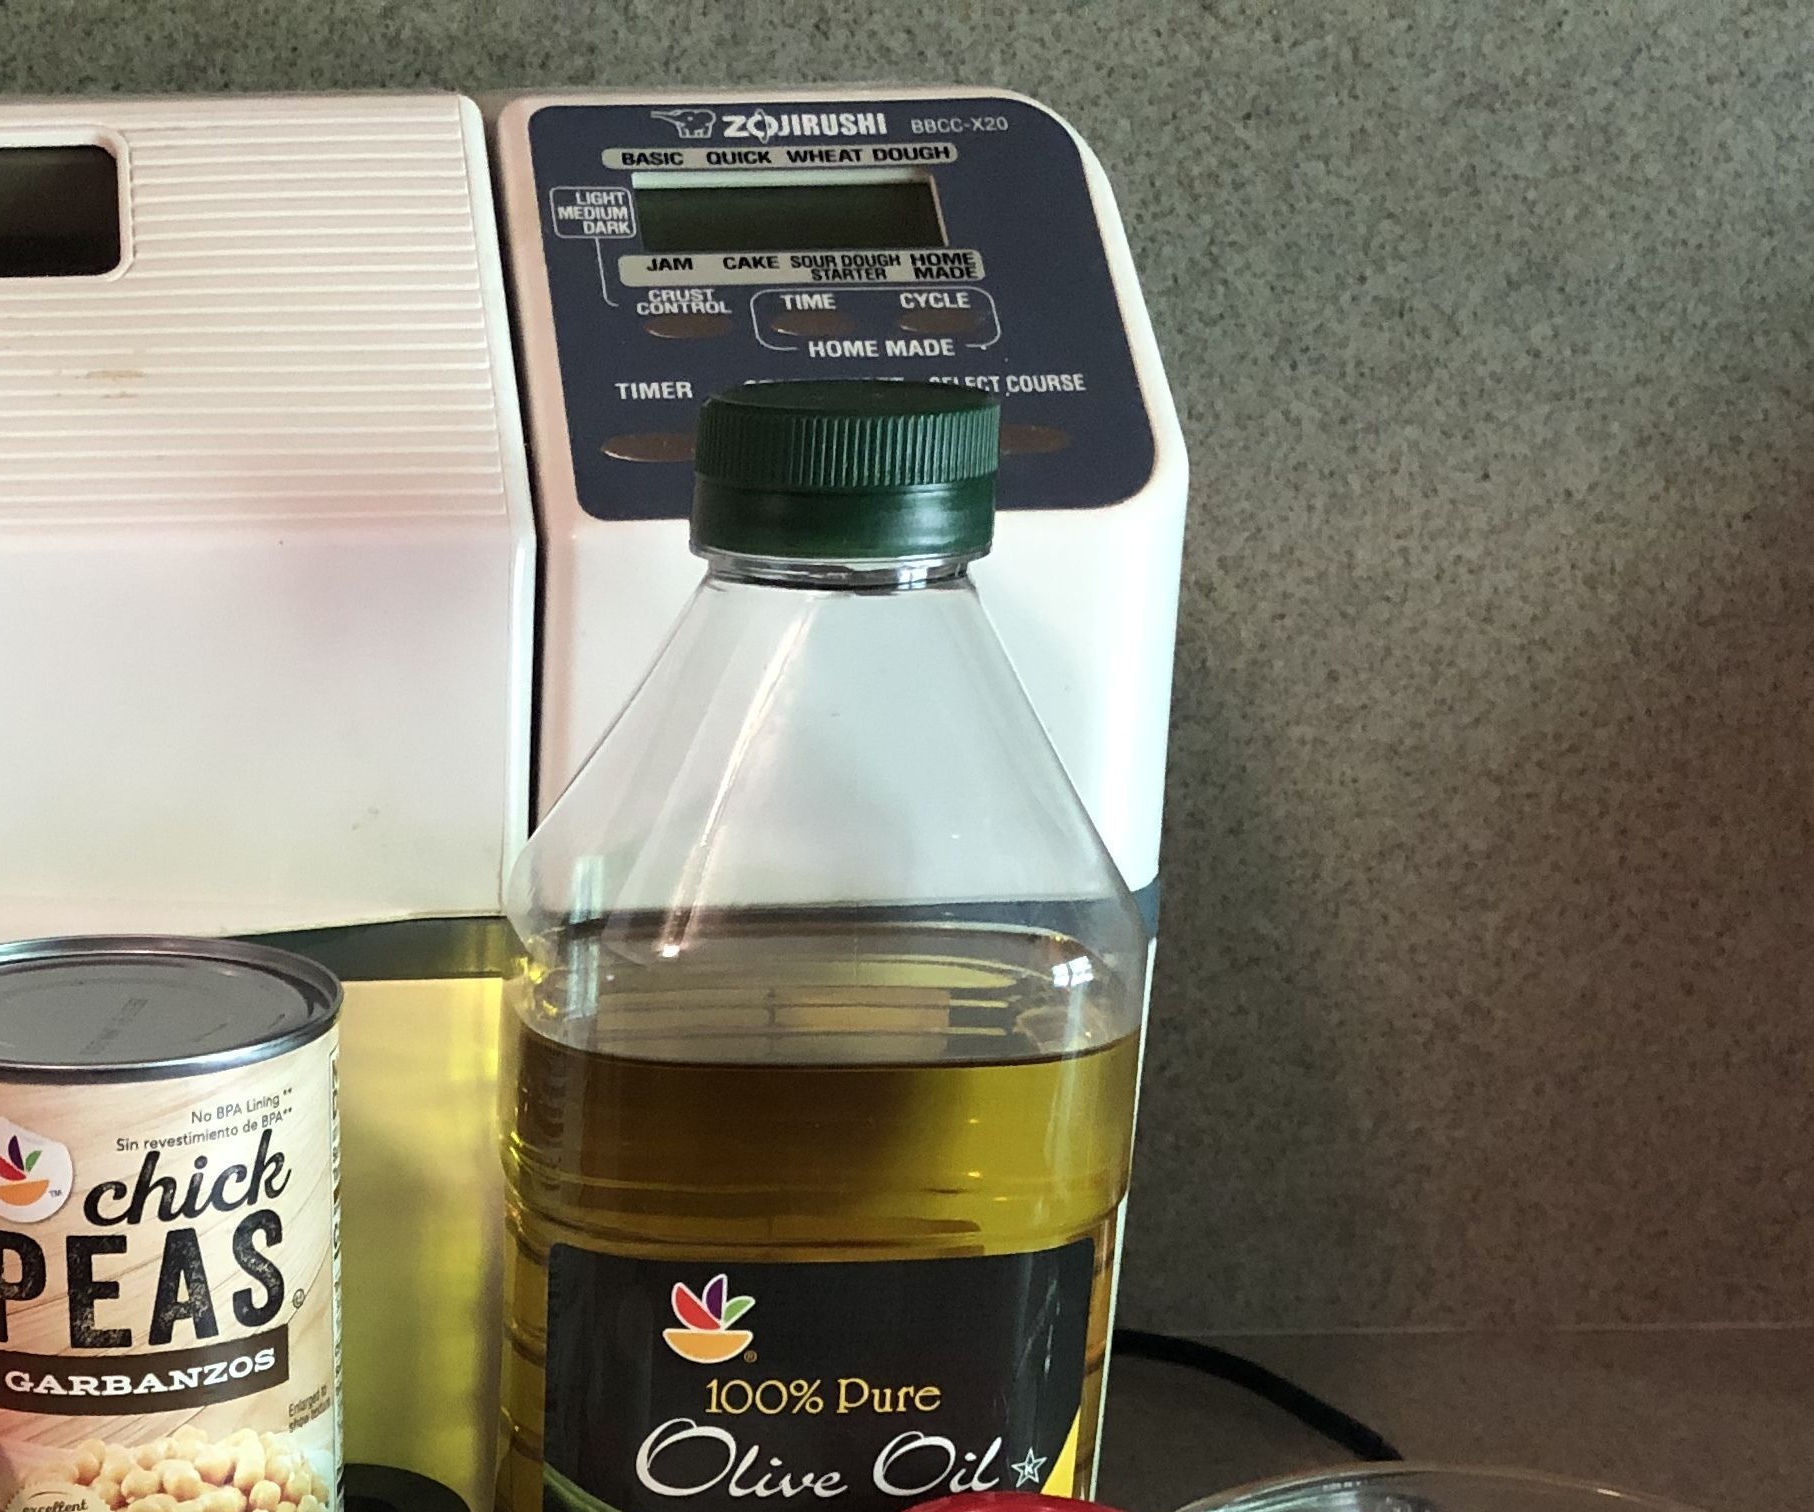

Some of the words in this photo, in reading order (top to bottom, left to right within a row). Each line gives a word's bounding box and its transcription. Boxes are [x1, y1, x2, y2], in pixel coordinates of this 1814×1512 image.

[723, 112, 886, 141] ZOJIRUSHI
[911, 116, 1008, 133] BBCC-X20
[621, 152, 684, 166] BASIC
[706, 149, 772, 165] QUICK
[787, 147, 862, 164] WHEAT
[872, 146, 950, 162] DOUGH
[575, 191, 624, 206] LIGHT
[558, 206, 628, 221] MEDIUM
[584, 220, 631, 235] DARK
[647, 257, 693, 272] JAM
[723, 255, 779, 271] CAKE
[791, 254, 837, 269] SOUR
[841, 253, 900, 268] DOUGH
[911, 252, 974, 267] HOME
[811, 268, 886, 282] STARTER
[915, 265, 977, 280] MADE
[648, 289, 714, 304] CRUST
[784, 294, 835, 310] TIME
[900, 293, 970, 309] CYCLE
[637, 300, 731, 316] CONTROL
[809, 340, 878, 357] HOME
[886, 340, 954, 357] MADE
[616, 382, 692, 400] TIMER
[1007, 374, 1085, 393] COURSE
[192, 1111, 211, 1123] No
[217, 1104, 242, 1119] BPA
[116, 1139, 138, 1151] Sin
[144, 1125, 238, 1149] revestimiento
[243, 1120, 258, 1133] de
[84, 1129, 291, 1226] chick
[5, 1348, 275, 1398] GARBANZOS
[705, 1378, 824, 1415] 100%
[836, 1378, 941, 1414] Pure
[635, 1417, 848, 1498] Olive
[872, 1430, 1002, 1496] Oil
